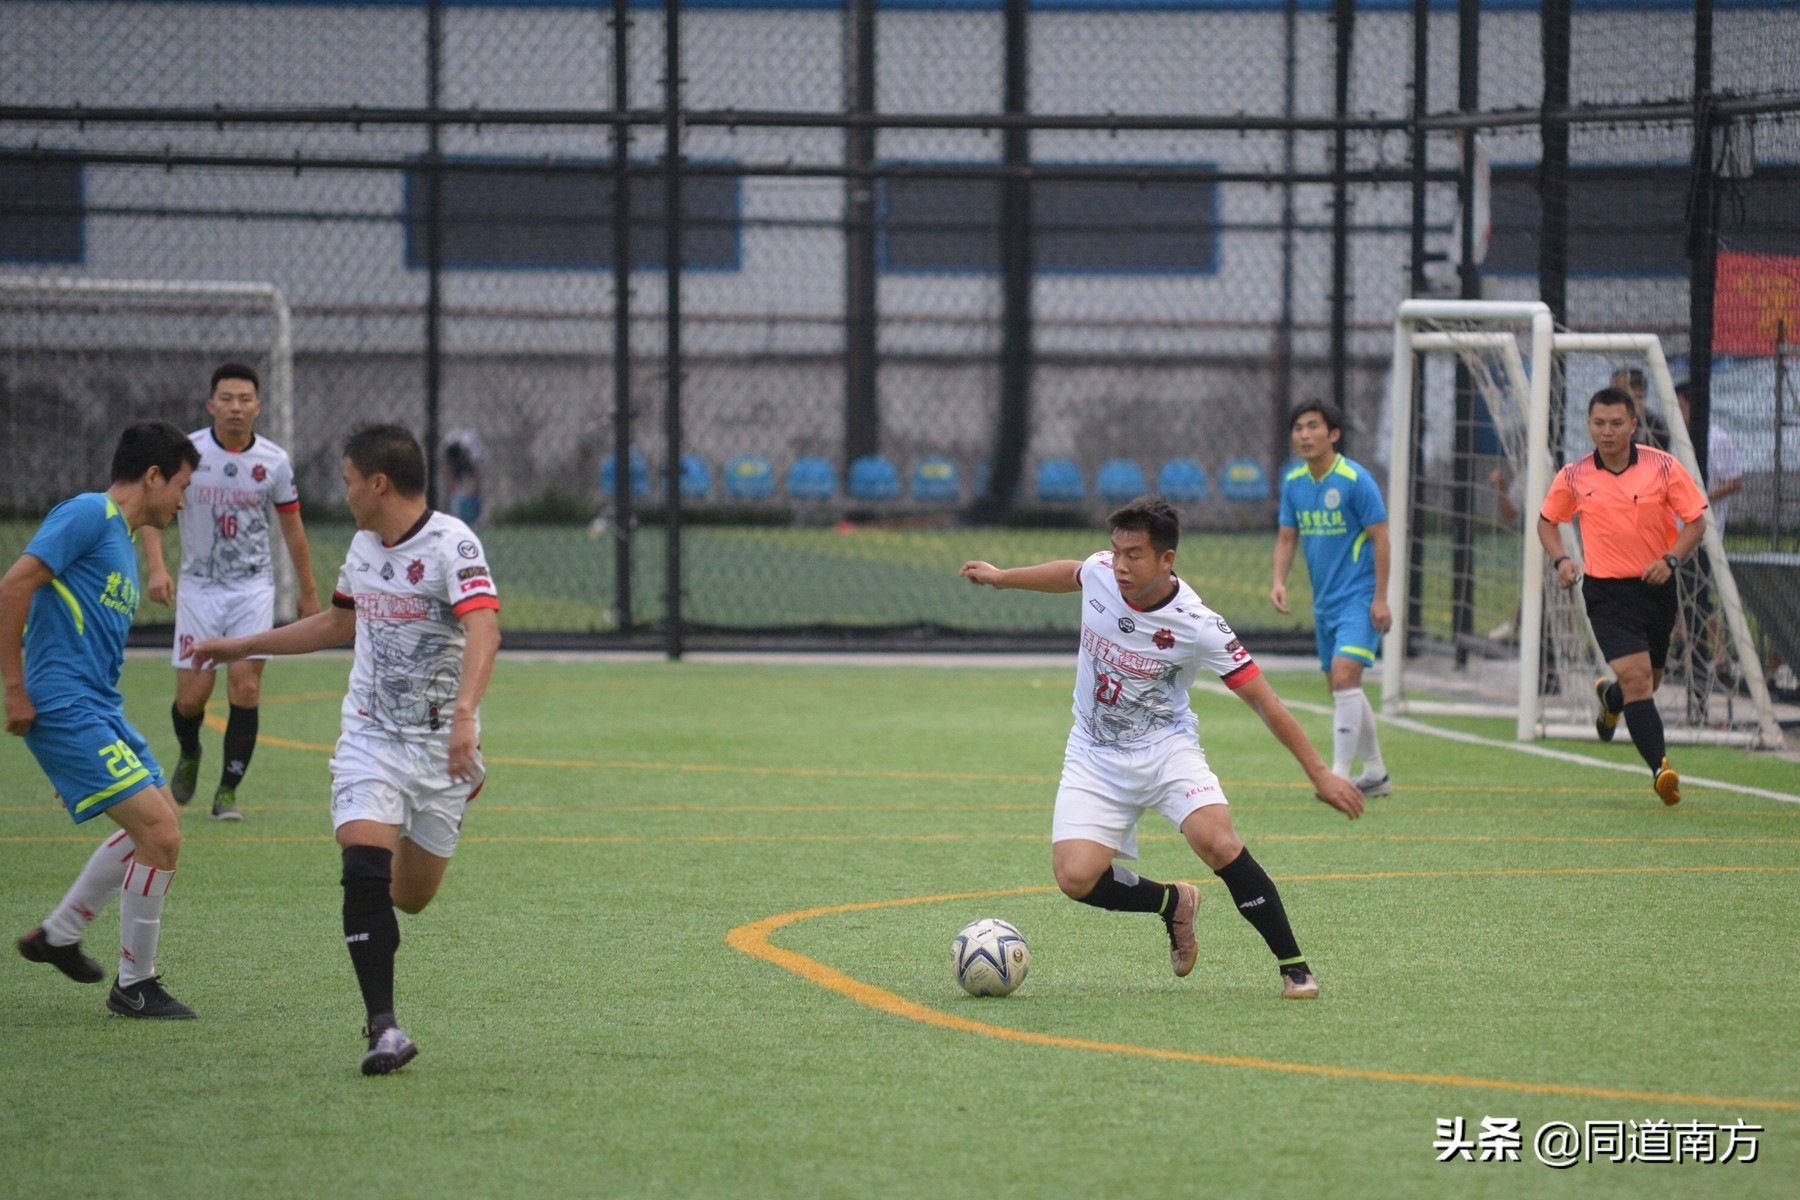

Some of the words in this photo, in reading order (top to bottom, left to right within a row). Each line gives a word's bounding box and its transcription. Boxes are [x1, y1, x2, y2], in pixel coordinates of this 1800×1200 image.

[219, 513, 238, 539] 16
[1095, 673, 1123, 707] 27
[1184, 785, 1216, 799] KELME
